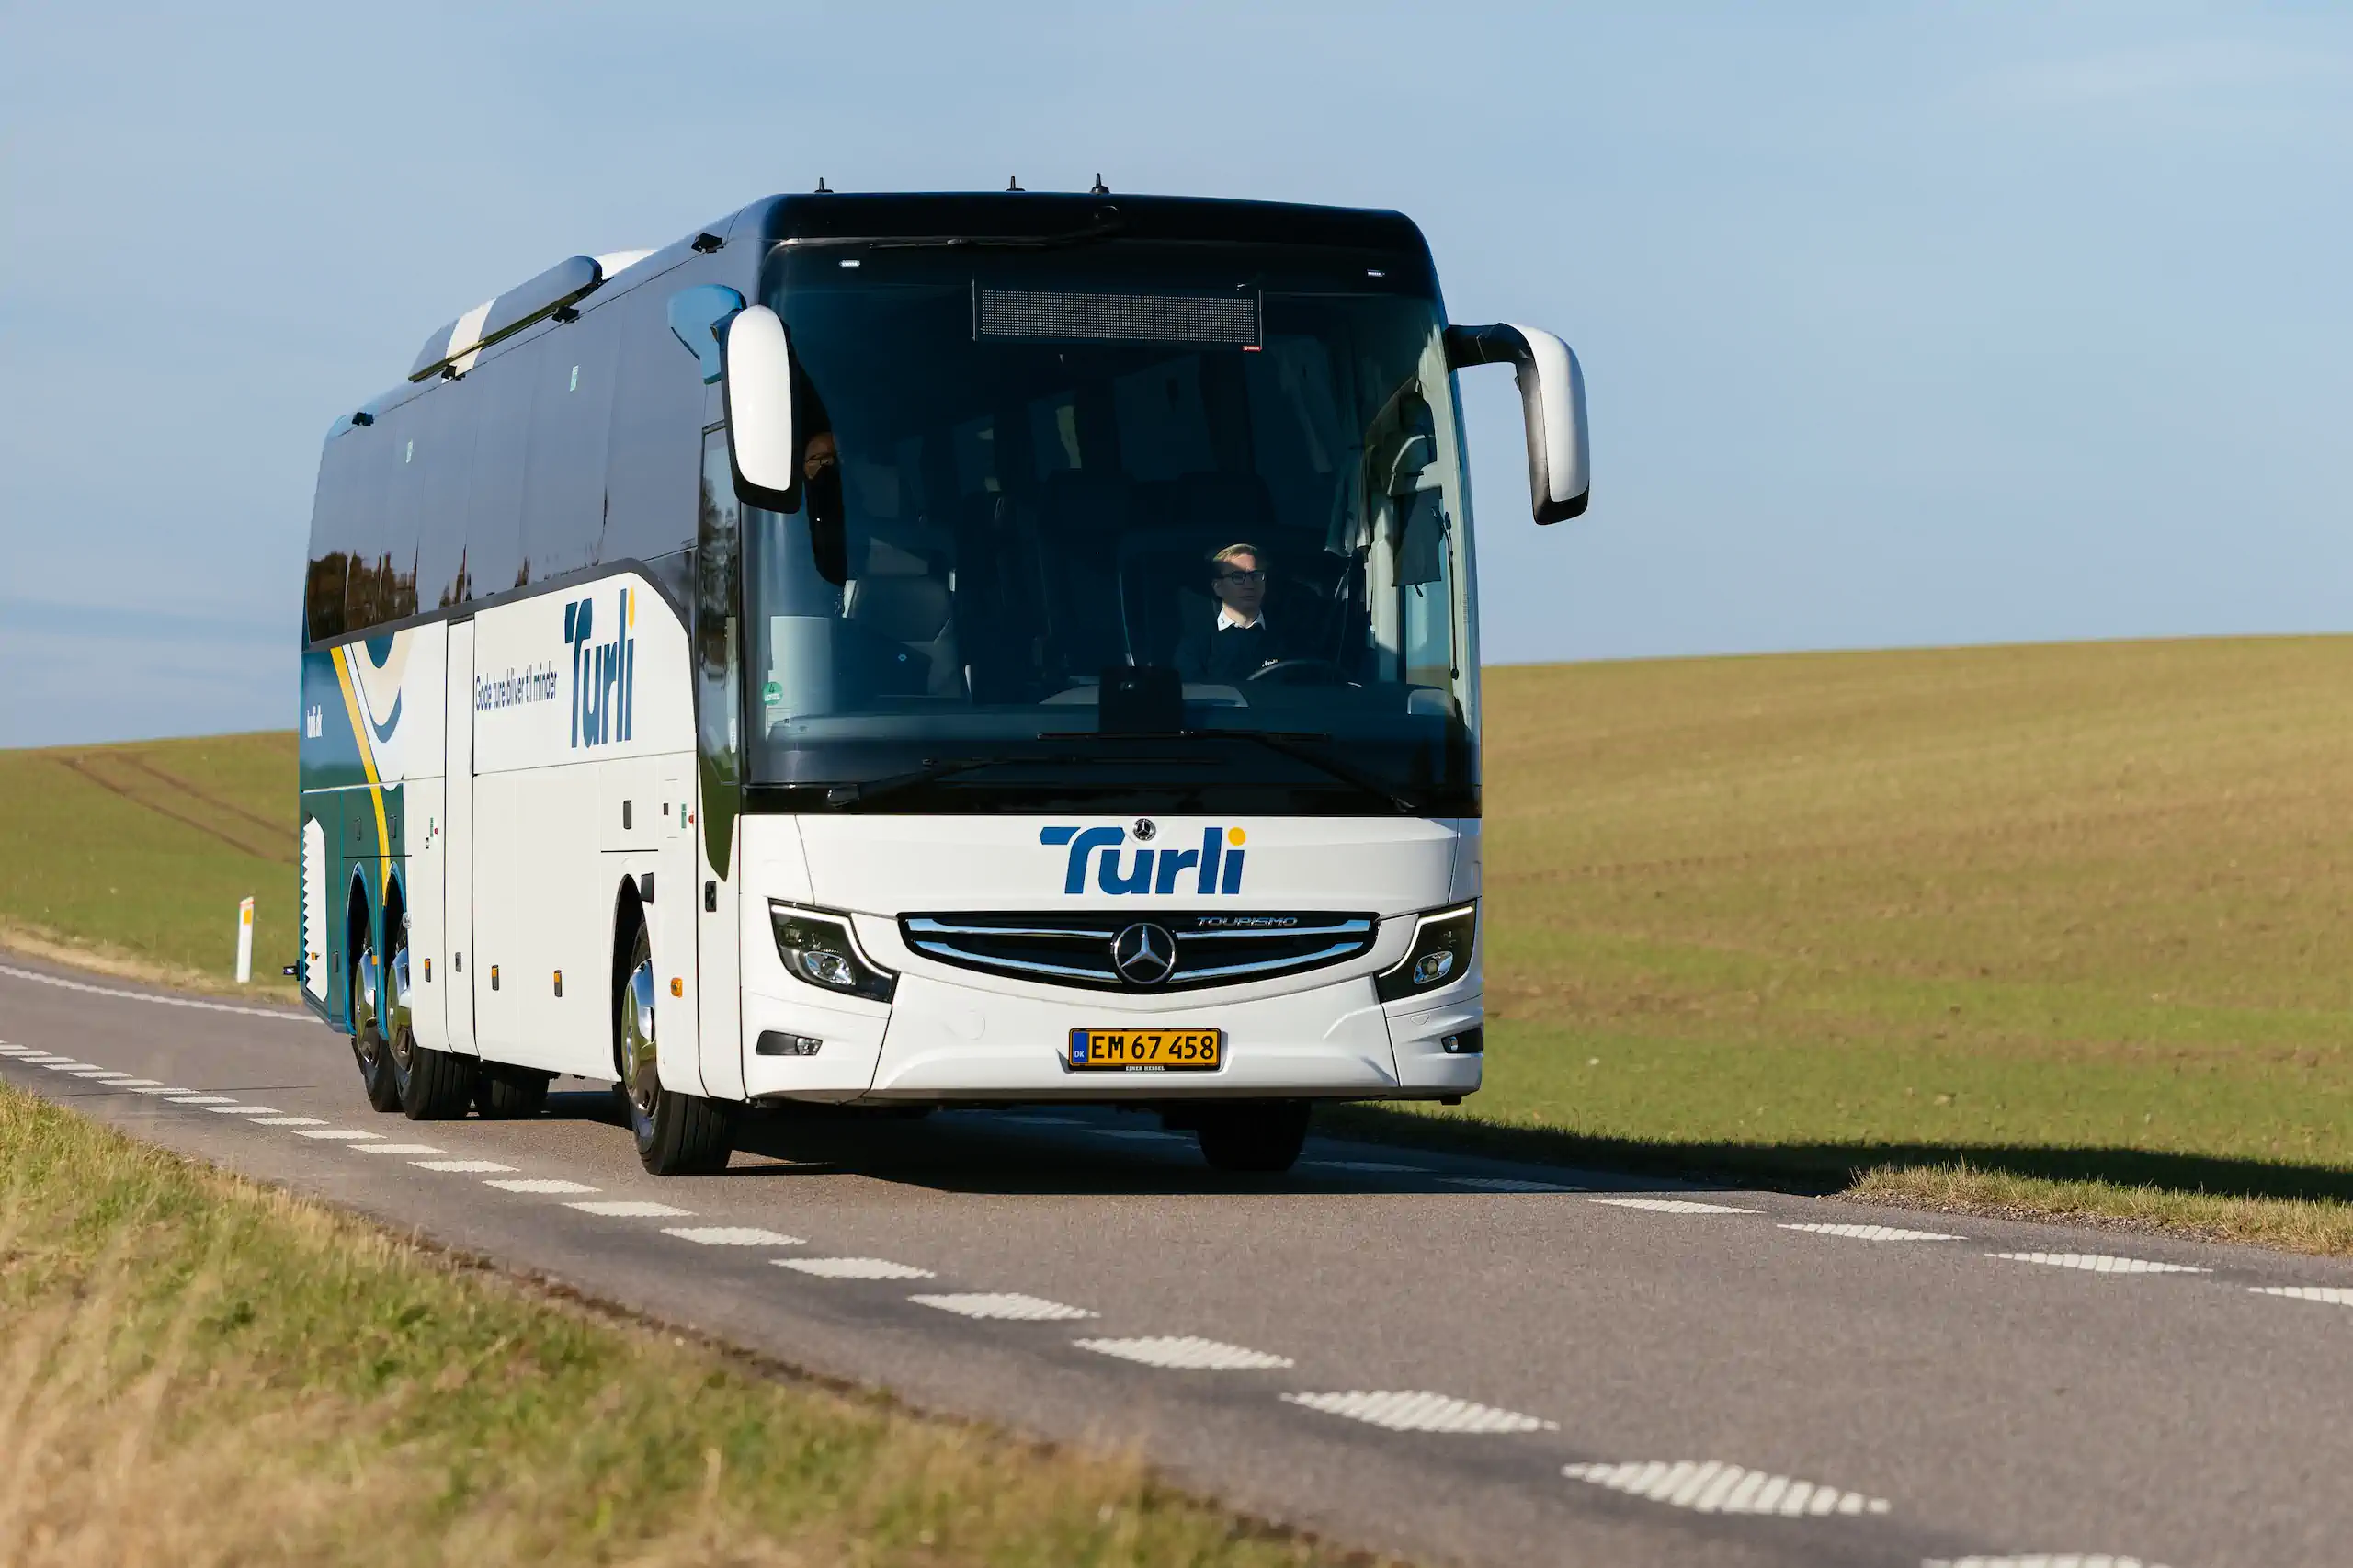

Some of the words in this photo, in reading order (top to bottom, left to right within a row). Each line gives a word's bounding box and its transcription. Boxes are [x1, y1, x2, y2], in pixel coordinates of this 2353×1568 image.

[475, 672, 492, 711] Gode
[493, 676, 506, 709] ture
[506, 667, 525, 707] bliver
[533, 660, 557, 701] minder
[564, 585, 635, 748] Turli
[1040, 826, 1246, 895] Turli
[1197, 916, 1298, 926] TOURISMO
[1091, 1036, 1124, 1059] EM
[1131, 1035, 1162, 1059] 67
[1168, 1036, 1214, 1059] 458
